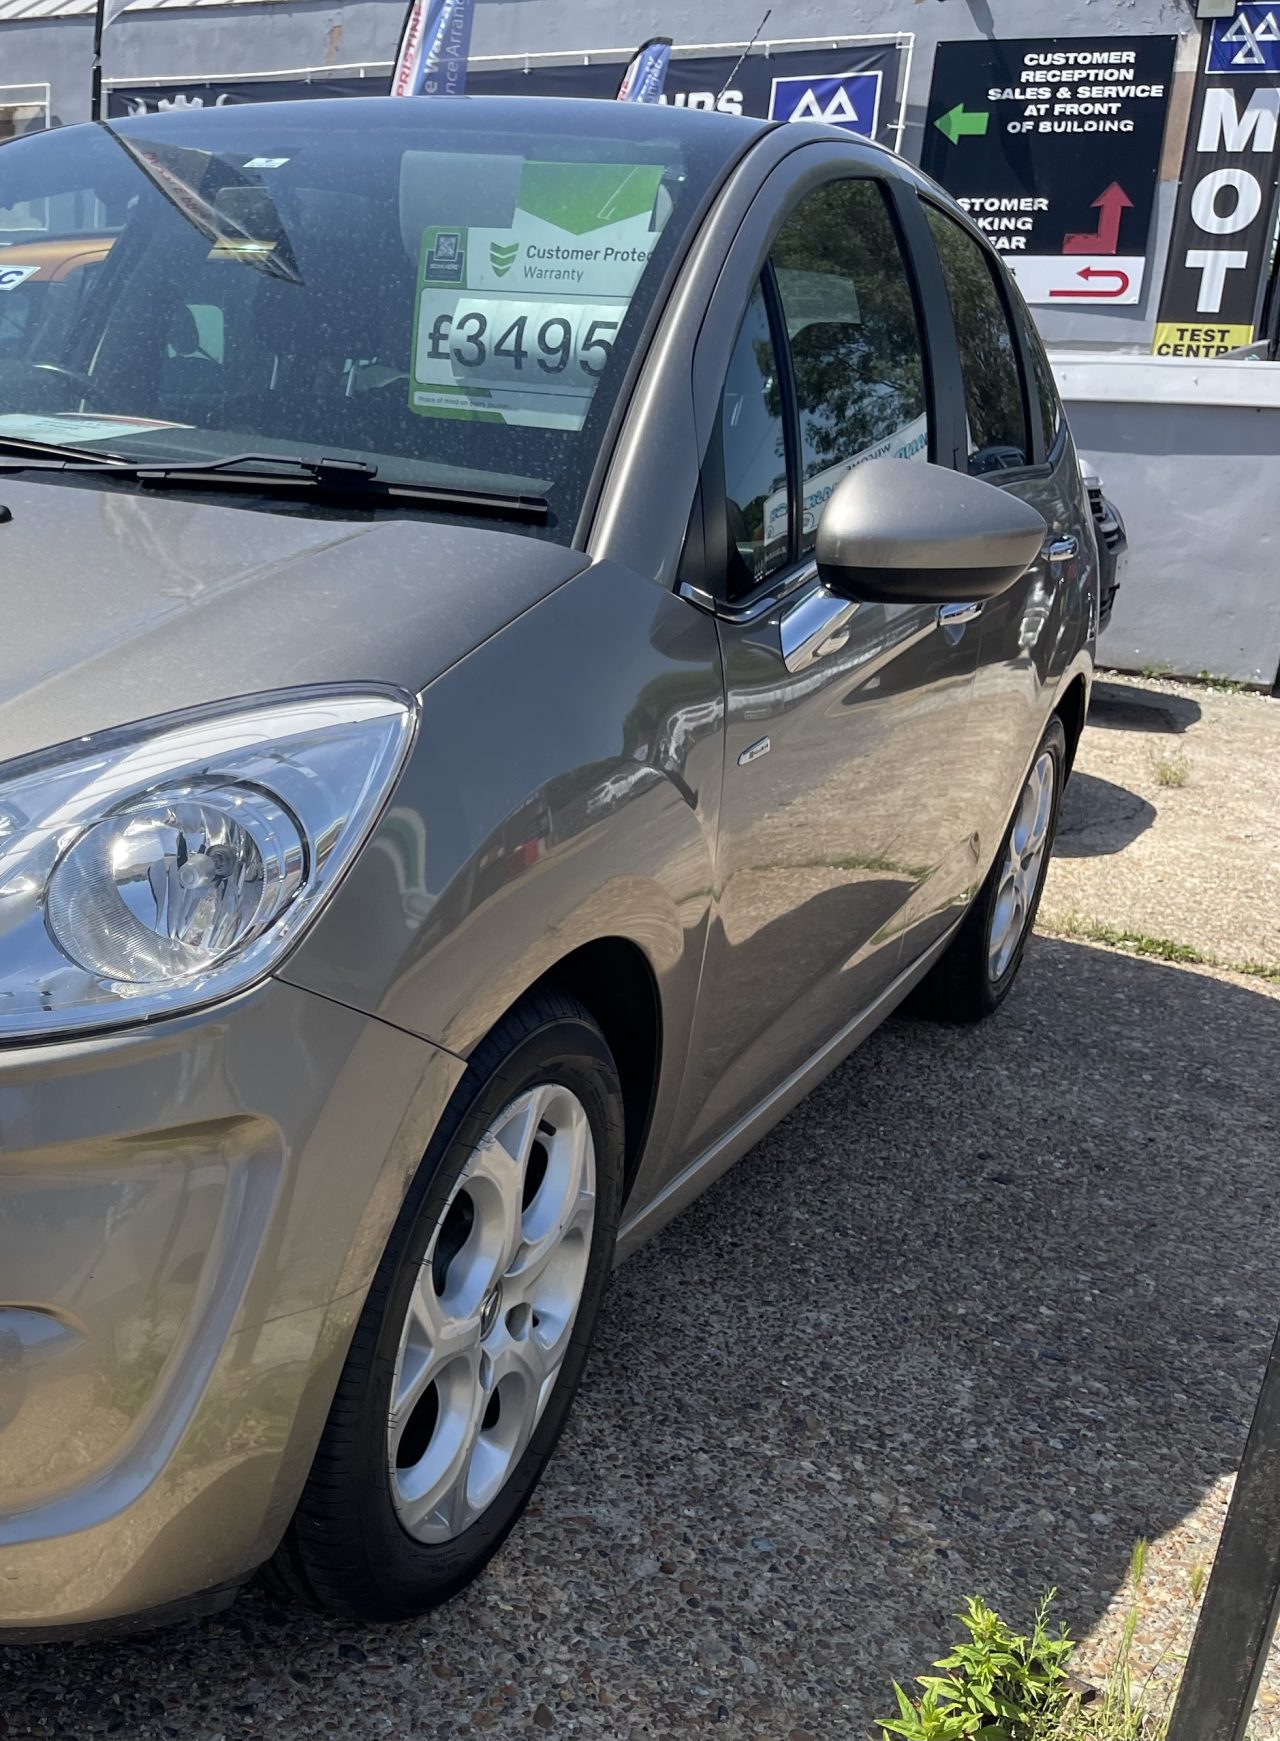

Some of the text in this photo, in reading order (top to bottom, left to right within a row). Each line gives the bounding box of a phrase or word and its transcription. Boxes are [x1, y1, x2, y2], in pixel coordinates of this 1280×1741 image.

[1024, 51, 1136, 66] CUSTOMER
[1020, 69, 1135, 83] RECEPTION
[987, 85, 1164, 101] SALES & SERVICE
[1024, 102, 1121, 117] AT FRONT
[1007, 120, 1135, 134] OF BUILDING
[956, 197, 1049, 212] STOMER
[973, 216, 1034, 231] KING
[526, 245, 600, 260] Customer
[523, 265, 584, 283] Warranty
[1176, 328, 1231, 343] TEST
[427, 312, 619, 377] £3495
[1157, 343, 1241, 358] CENTR
